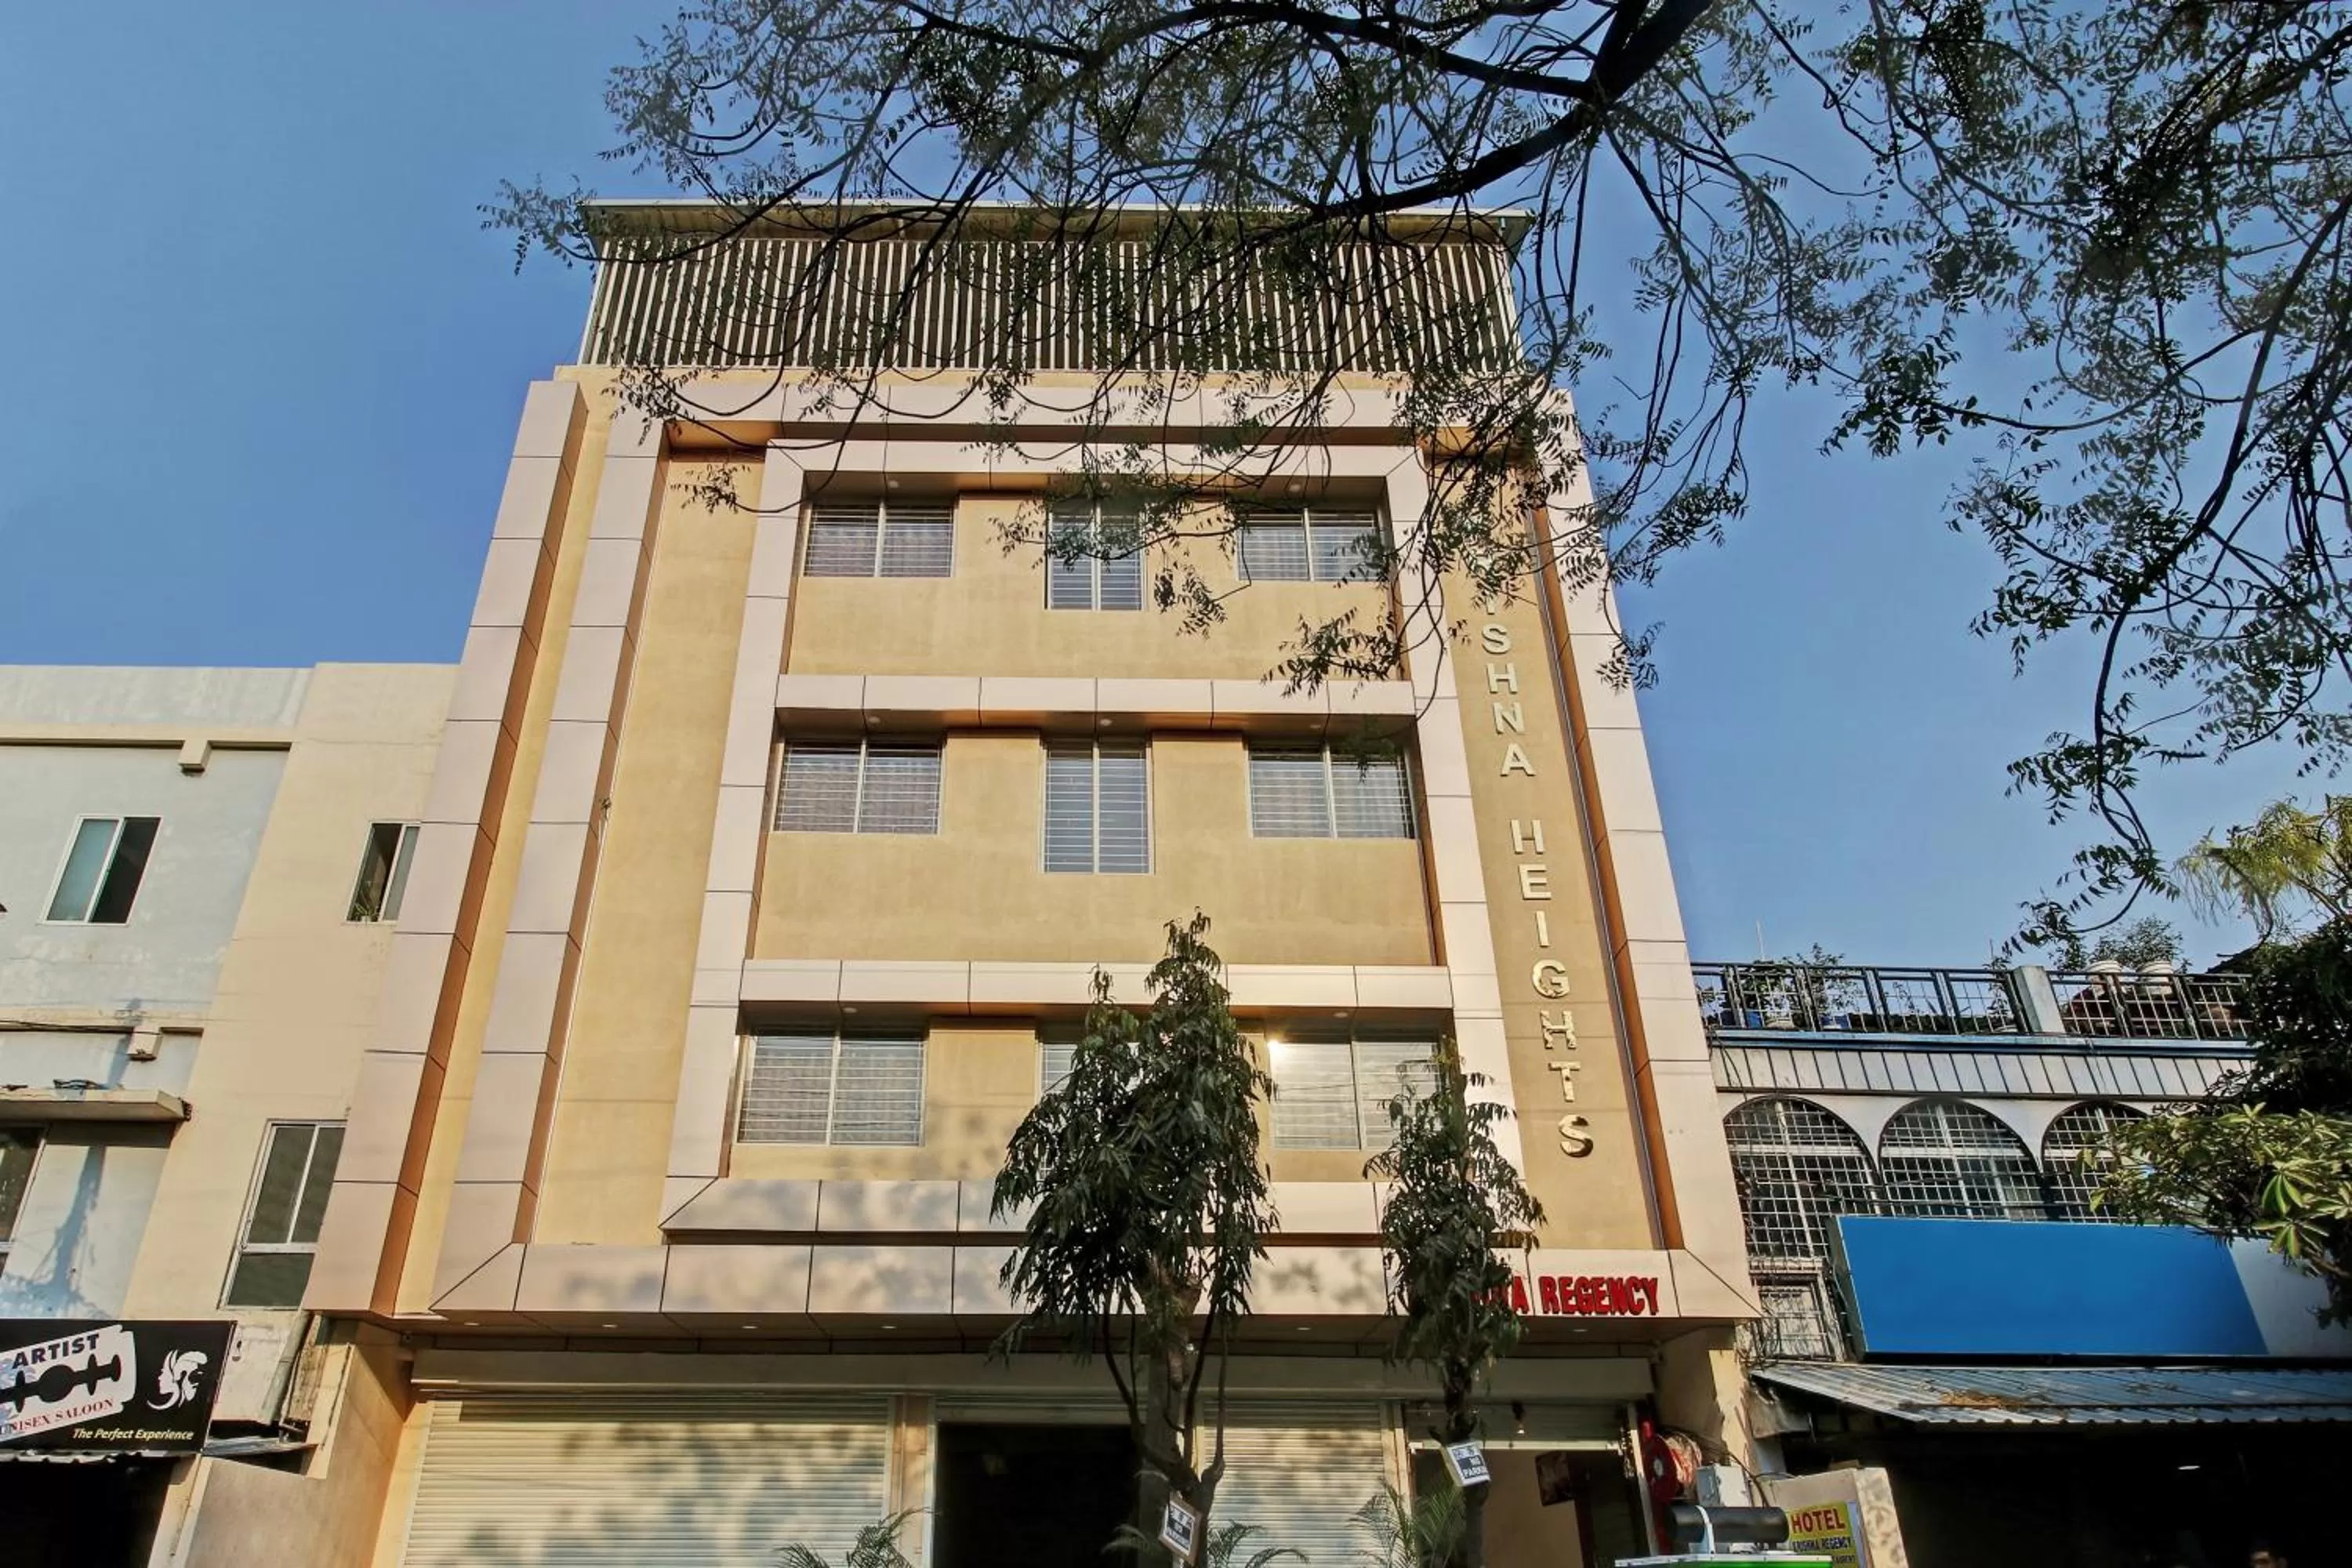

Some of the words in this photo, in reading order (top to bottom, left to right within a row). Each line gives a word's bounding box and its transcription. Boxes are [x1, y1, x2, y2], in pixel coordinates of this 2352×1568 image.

[1509, 818, 1594, 1158] HEIGHTS
[1538, 1276, 1659, 1316] REGENCY
[12, 1334, 99, 1370] ARTIST
[55, 1399, 114, 1422] SALOON
[72, 1428, 93, 1439] The
[94, 1428, 134, 1441] Perfect
[134, 1428, 194, 1441] Experience
[1791, 1508, 1845, 1534] HOTEL
